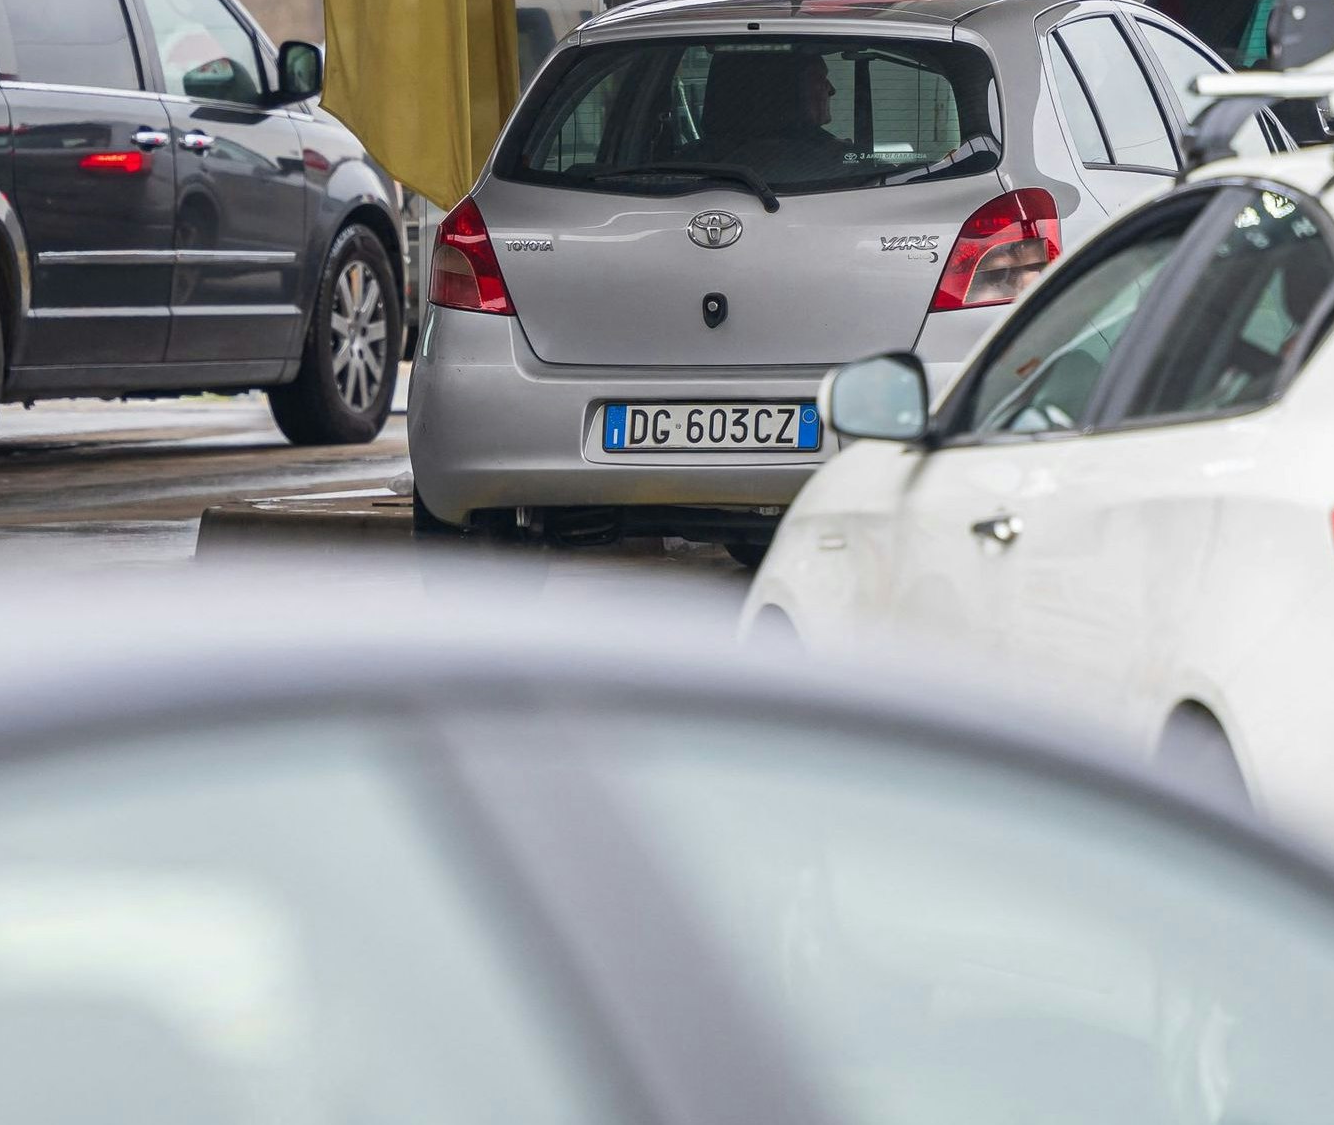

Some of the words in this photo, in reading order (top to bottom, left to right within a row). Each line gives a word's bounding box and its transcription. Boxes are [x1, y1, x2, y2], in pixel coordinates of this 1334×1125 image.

[505, 239, 555, 251] TOYOTA
[629, 408, 671, 445] DG
[686, 408, 796, 444] 603CZ
